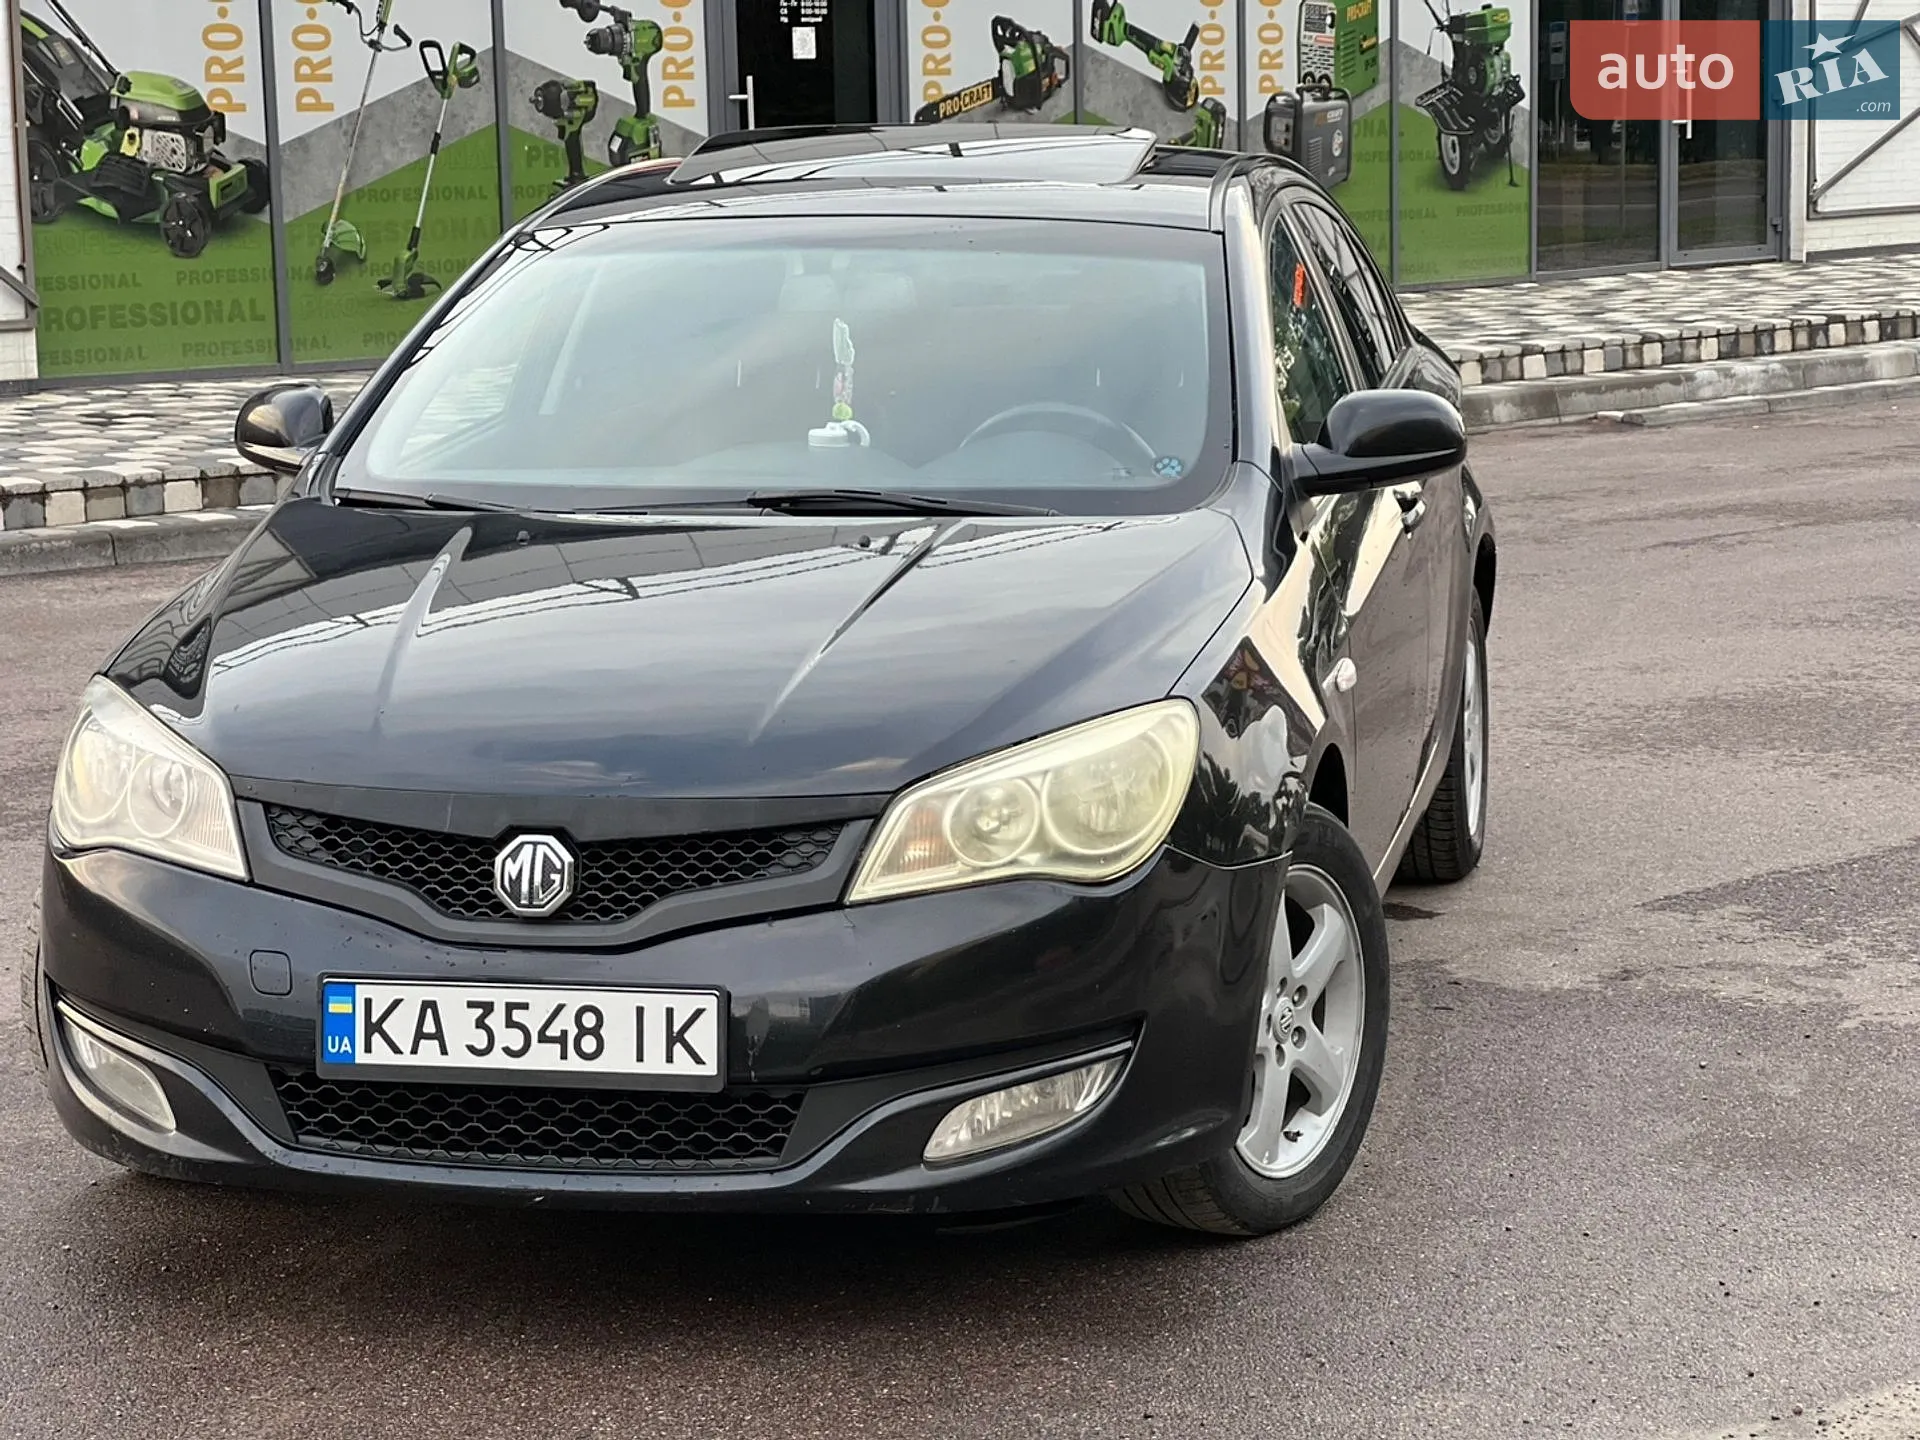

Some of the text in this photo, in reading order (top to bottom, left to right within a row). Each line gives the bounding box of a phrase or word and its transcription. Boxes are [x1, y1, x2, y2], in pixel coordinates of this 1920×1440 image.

[503, 843, 562, 905] MG
[327, 1035, 352, 1054] UA
[363, 997, 707, 1065] KA 3548 IK
